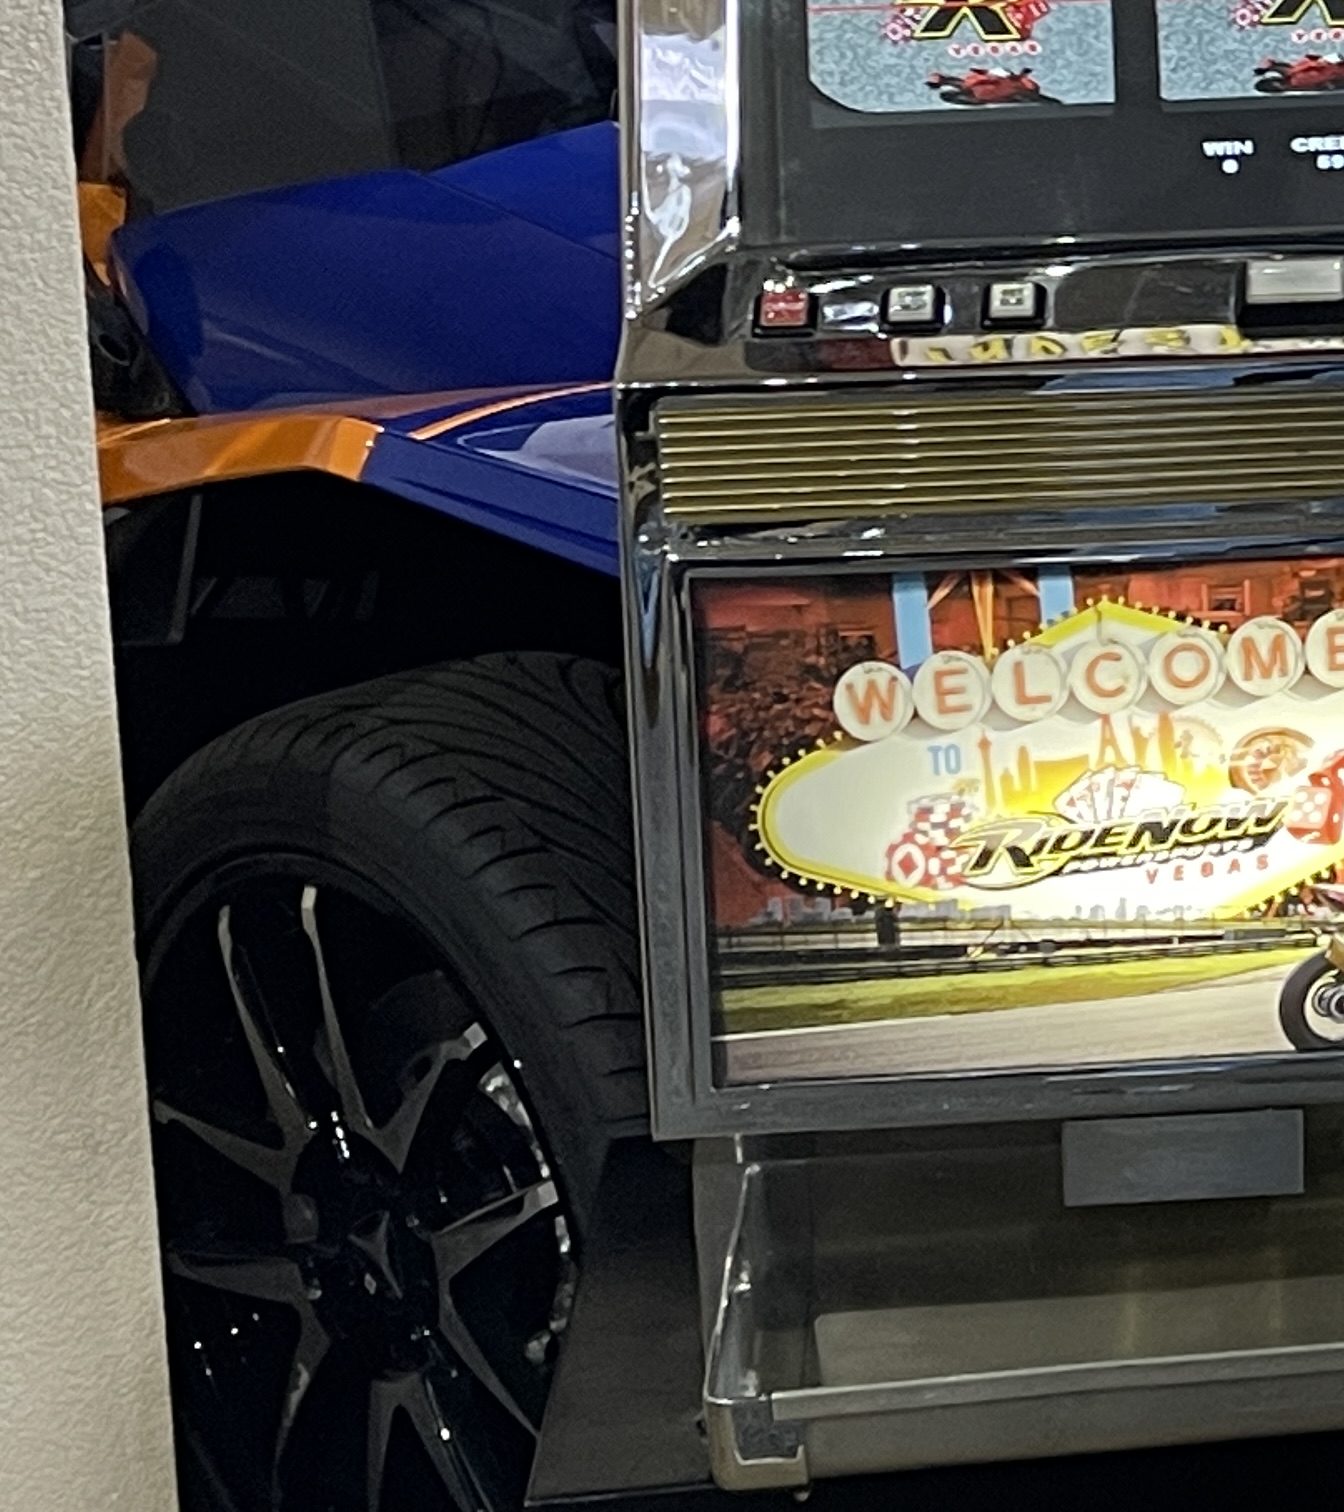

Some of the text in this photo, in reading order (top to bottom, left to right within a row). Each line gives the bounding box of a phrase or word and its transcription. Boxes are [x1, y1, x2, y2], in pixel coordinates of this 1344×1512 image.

[1202, 140, 1254, 157] WIN
[927, 743, 962, 777] TO
[1144, 853, 1270, 885] VEGAS
